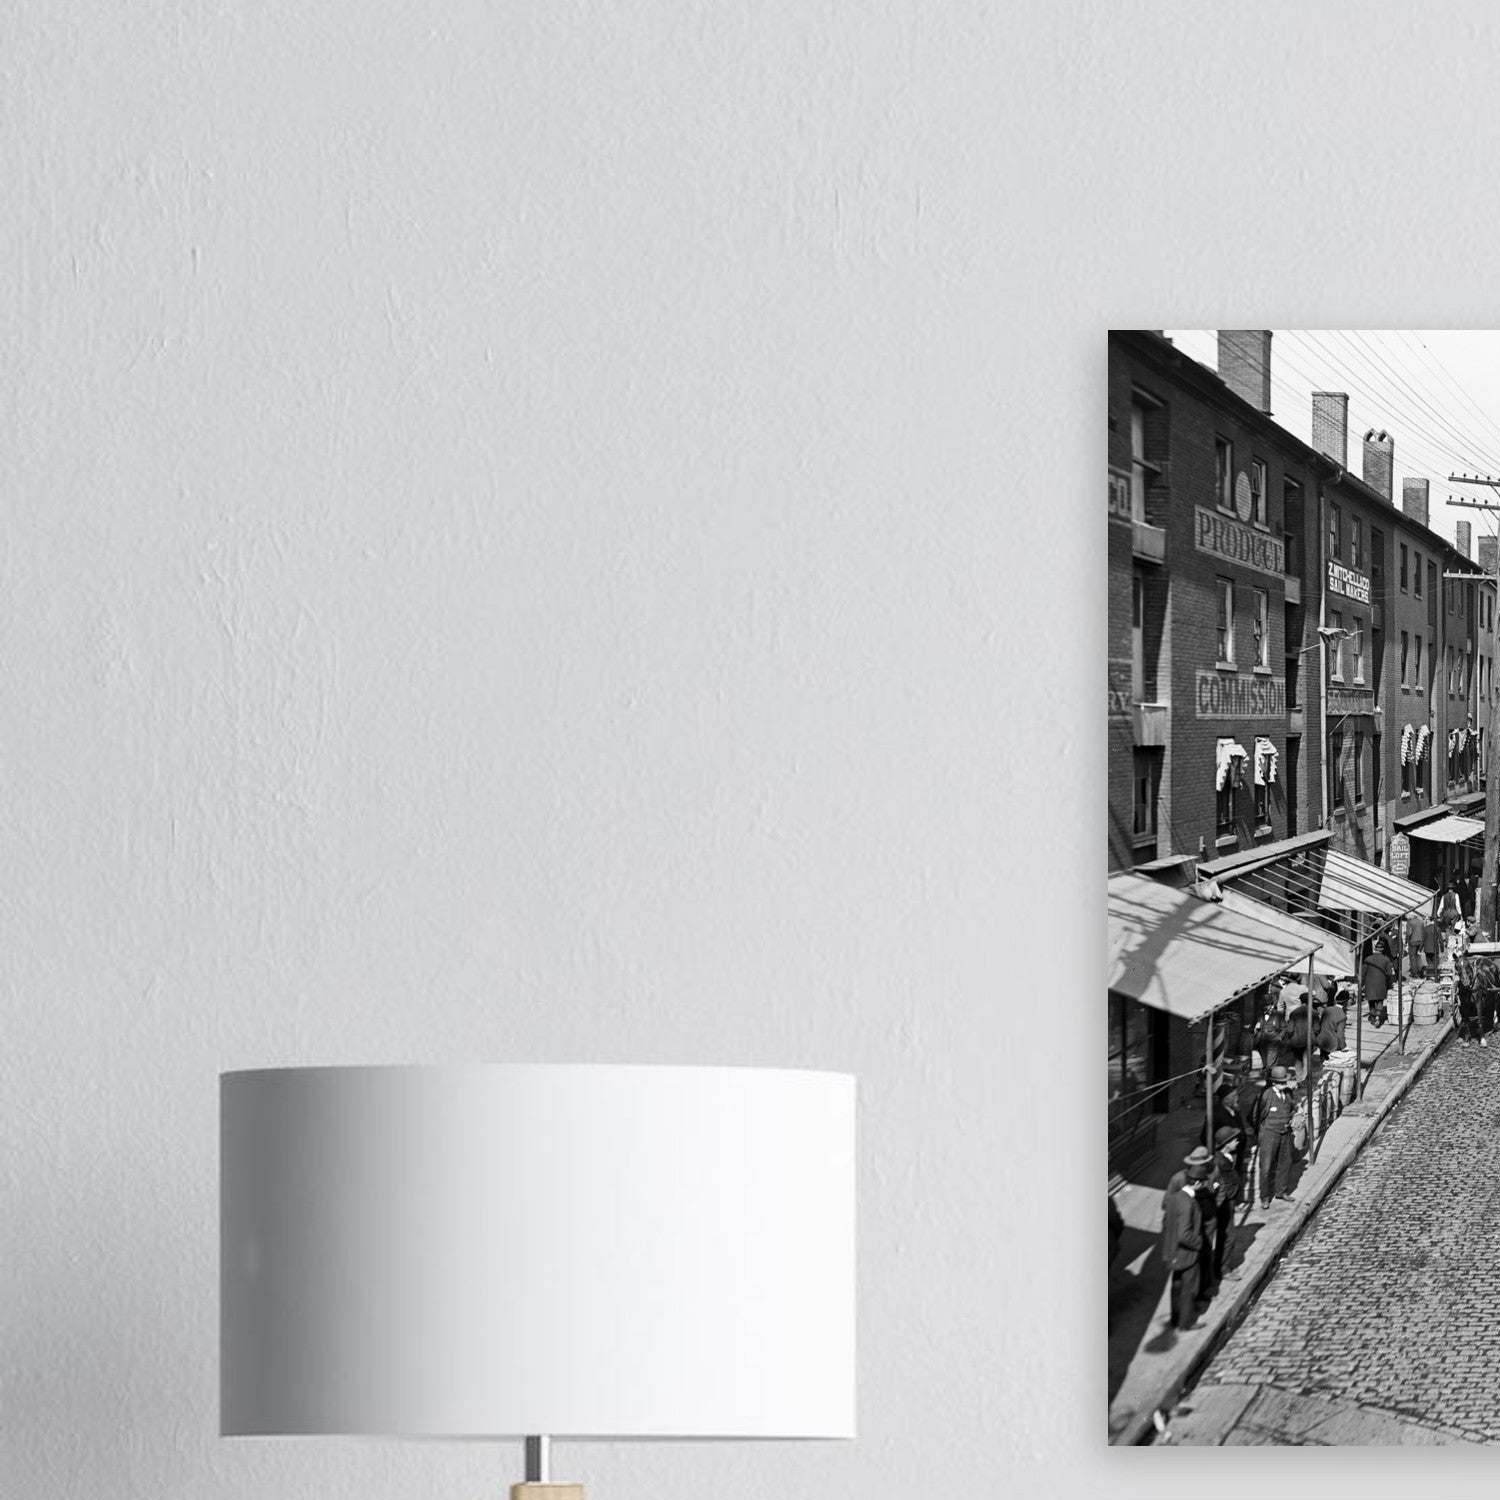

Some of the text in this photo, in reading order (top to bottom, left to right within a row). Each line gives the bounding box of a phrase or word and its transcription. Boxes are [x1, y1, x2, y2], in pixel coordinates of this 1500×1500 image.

[1200, 511, 1285, 573] PRODUCE
[1329, 576, 1346, 596] SAIL
[1199, 675, 1286, 715] COMMISSION
